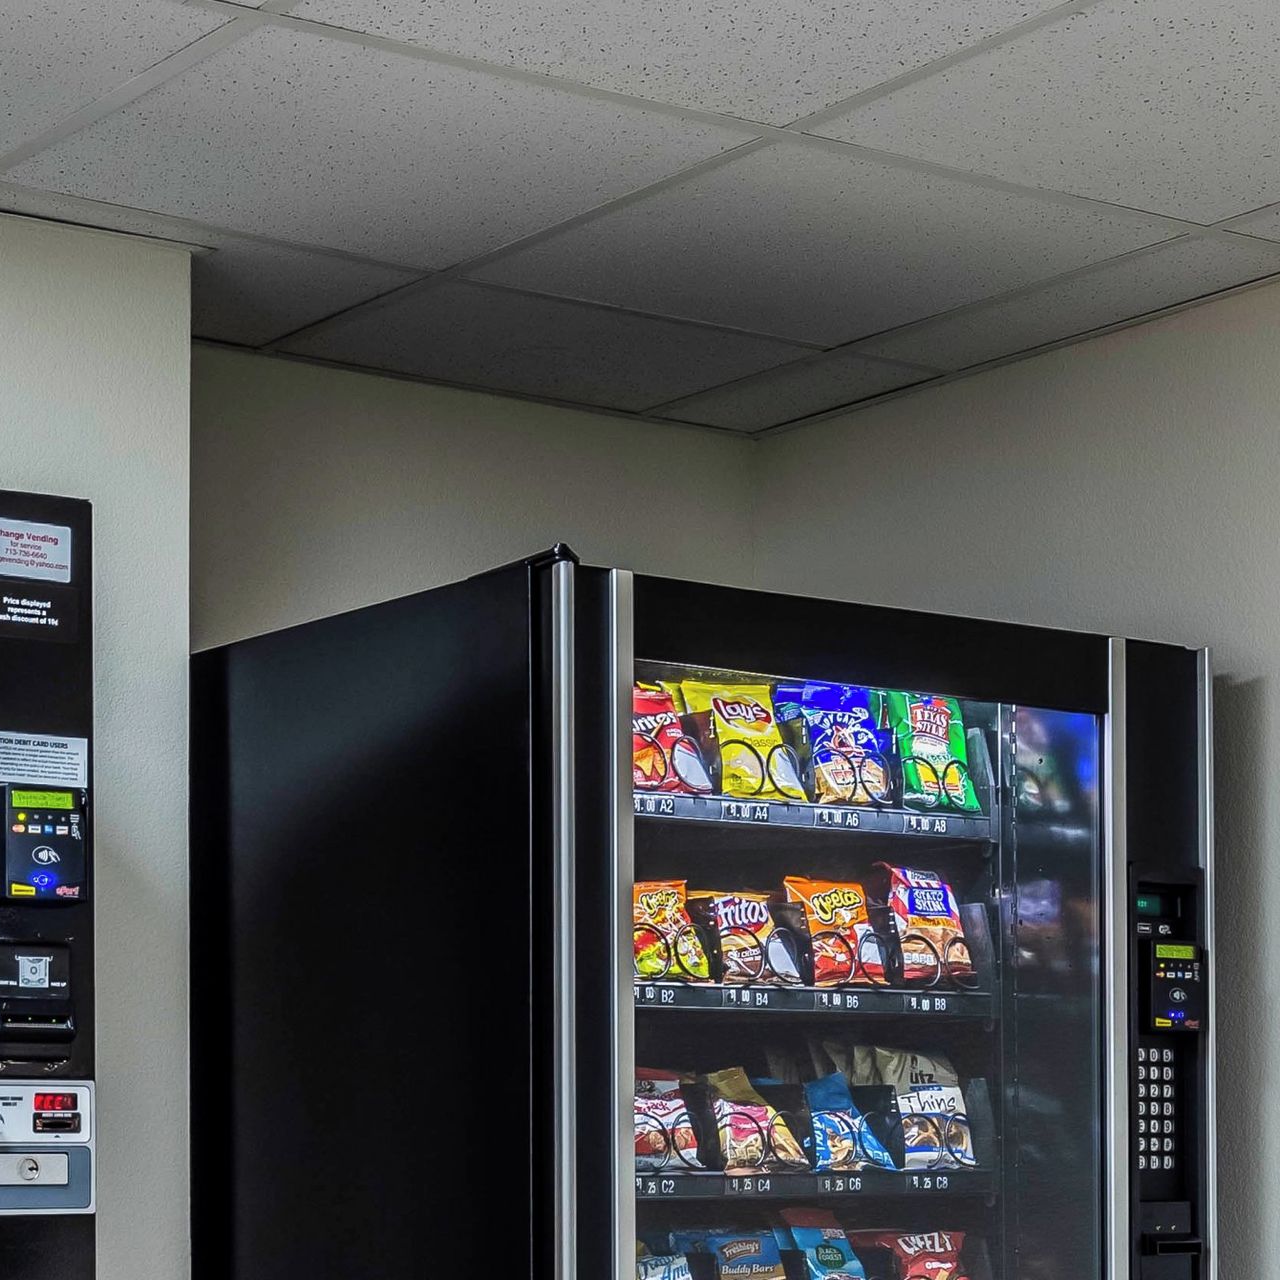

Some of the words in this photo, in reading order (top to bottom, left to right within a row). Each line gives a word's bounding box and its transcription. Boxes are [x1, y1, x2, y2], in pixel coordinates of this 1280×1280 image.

[26, 532, 58, 545] Vending
[3, 596, 20, 605] Price
[21, 599, 51, 609] displayed
[7, 607, 41, 616] represents
[12, 615, 39, 623] discount
[716, 698, 767, 721] Lay's
[913, 709, 947, 728] TEXAS
[916, 720, 946, 738] STYLE
[15, 738, 31, 746] DEBIT
[32, 739, 49, 748] CARD
[49, 741, 68, 749] USERS
[660, 799, 673, 813] A2
[755, 806, 768, 820] A4
[846, 813, 858, 826] A6
[934, 819, 946, 832] A8
[812, 890, 861, 921] Cheetos
[718, 897, 769, 929] Fritos
[662, 990, 674, 1003] B2
[756, 993, 768, 1005] B4
[846, 995, 858, 1008] B6
[934, 998, 946, 1010] B8
[1151, 1049, 1157, 1061] 0
[1164, 1049, 1170, 1061] 5
[910, 1070, 937, 1084] utz
[1151, 1067, 1157, 1079] 1
[1164, 1067, 1170, 1079] 6
[1151, 1085, 1157, 1097] 2
[1164, 1085, 1170, 1097] 7
[901, 1092, 957, 1114] Thins
[1151, 1103, 1157, 1115] 3
[1164, 1103, 1170, 1115] 8
[1164, 1121, 1170, 1133] 9
[1151, 1157, 1157, 1169] H
[1164, 1157, 1170, 1169] J
[662, 1180, 674, 1193] C2
[758, 1179, 770, 1191] C4
[849, 1177, 861, 1190] C6
[936, 1176, 948, 1189] C8
[722, 1241, 759, 1257] Freshley's
[722, 1264, 751, 1277] Buddy
[753, 1263, 774, 1272] Bars
